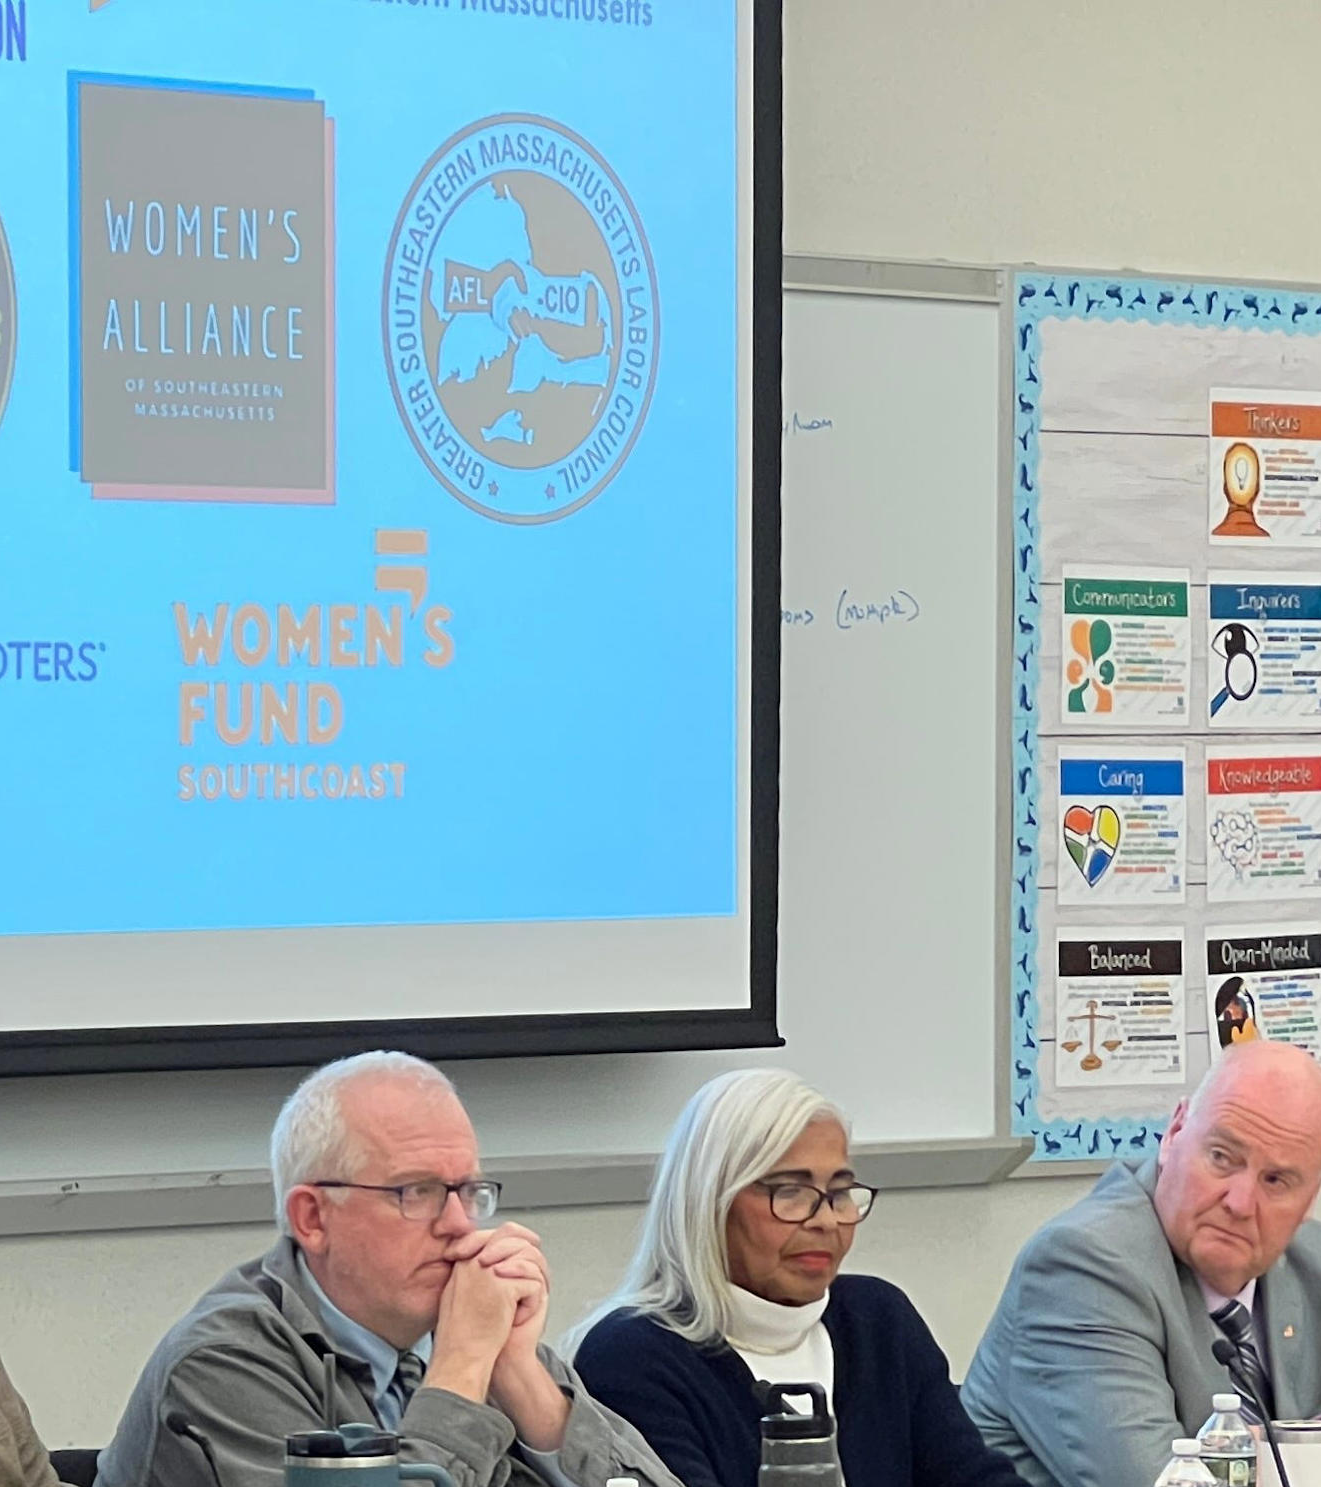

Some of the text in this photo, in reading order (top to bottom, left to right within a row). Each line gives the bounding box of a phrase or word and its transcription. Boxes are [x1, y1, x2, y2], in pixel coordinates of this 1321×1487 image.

[104, 198, 301, 264] WOMEN'S
[449, 276, 488, 306] AFL
[395, 133, 648, 493] GREATER SOUTHEASTERN MASSACHUSETTS LABOR COUNCIL
[103, 298, 303, 361] ALLIANCE
[125, 378, 284, 399] OF SOUTHEASTERN
[134, 402, 276, 422] MASSACHUSETTS
[1242, 407, 1300, 433] Thinkers
[1073, 583, 1176, 609] Communicators
[173, 598, 456, 668] WOMEN'S
[179, 681, 344, 747] FUND
[178, 762, 406, 802] SOUTHCOAST
[1099, 764, 1144, 795] Caring
[1219, 763, 1312, 791] Knowledgeable
[1088, 944, 1152, 971] Balanced
[1222, 939, 1310, 972] Open-Minded
